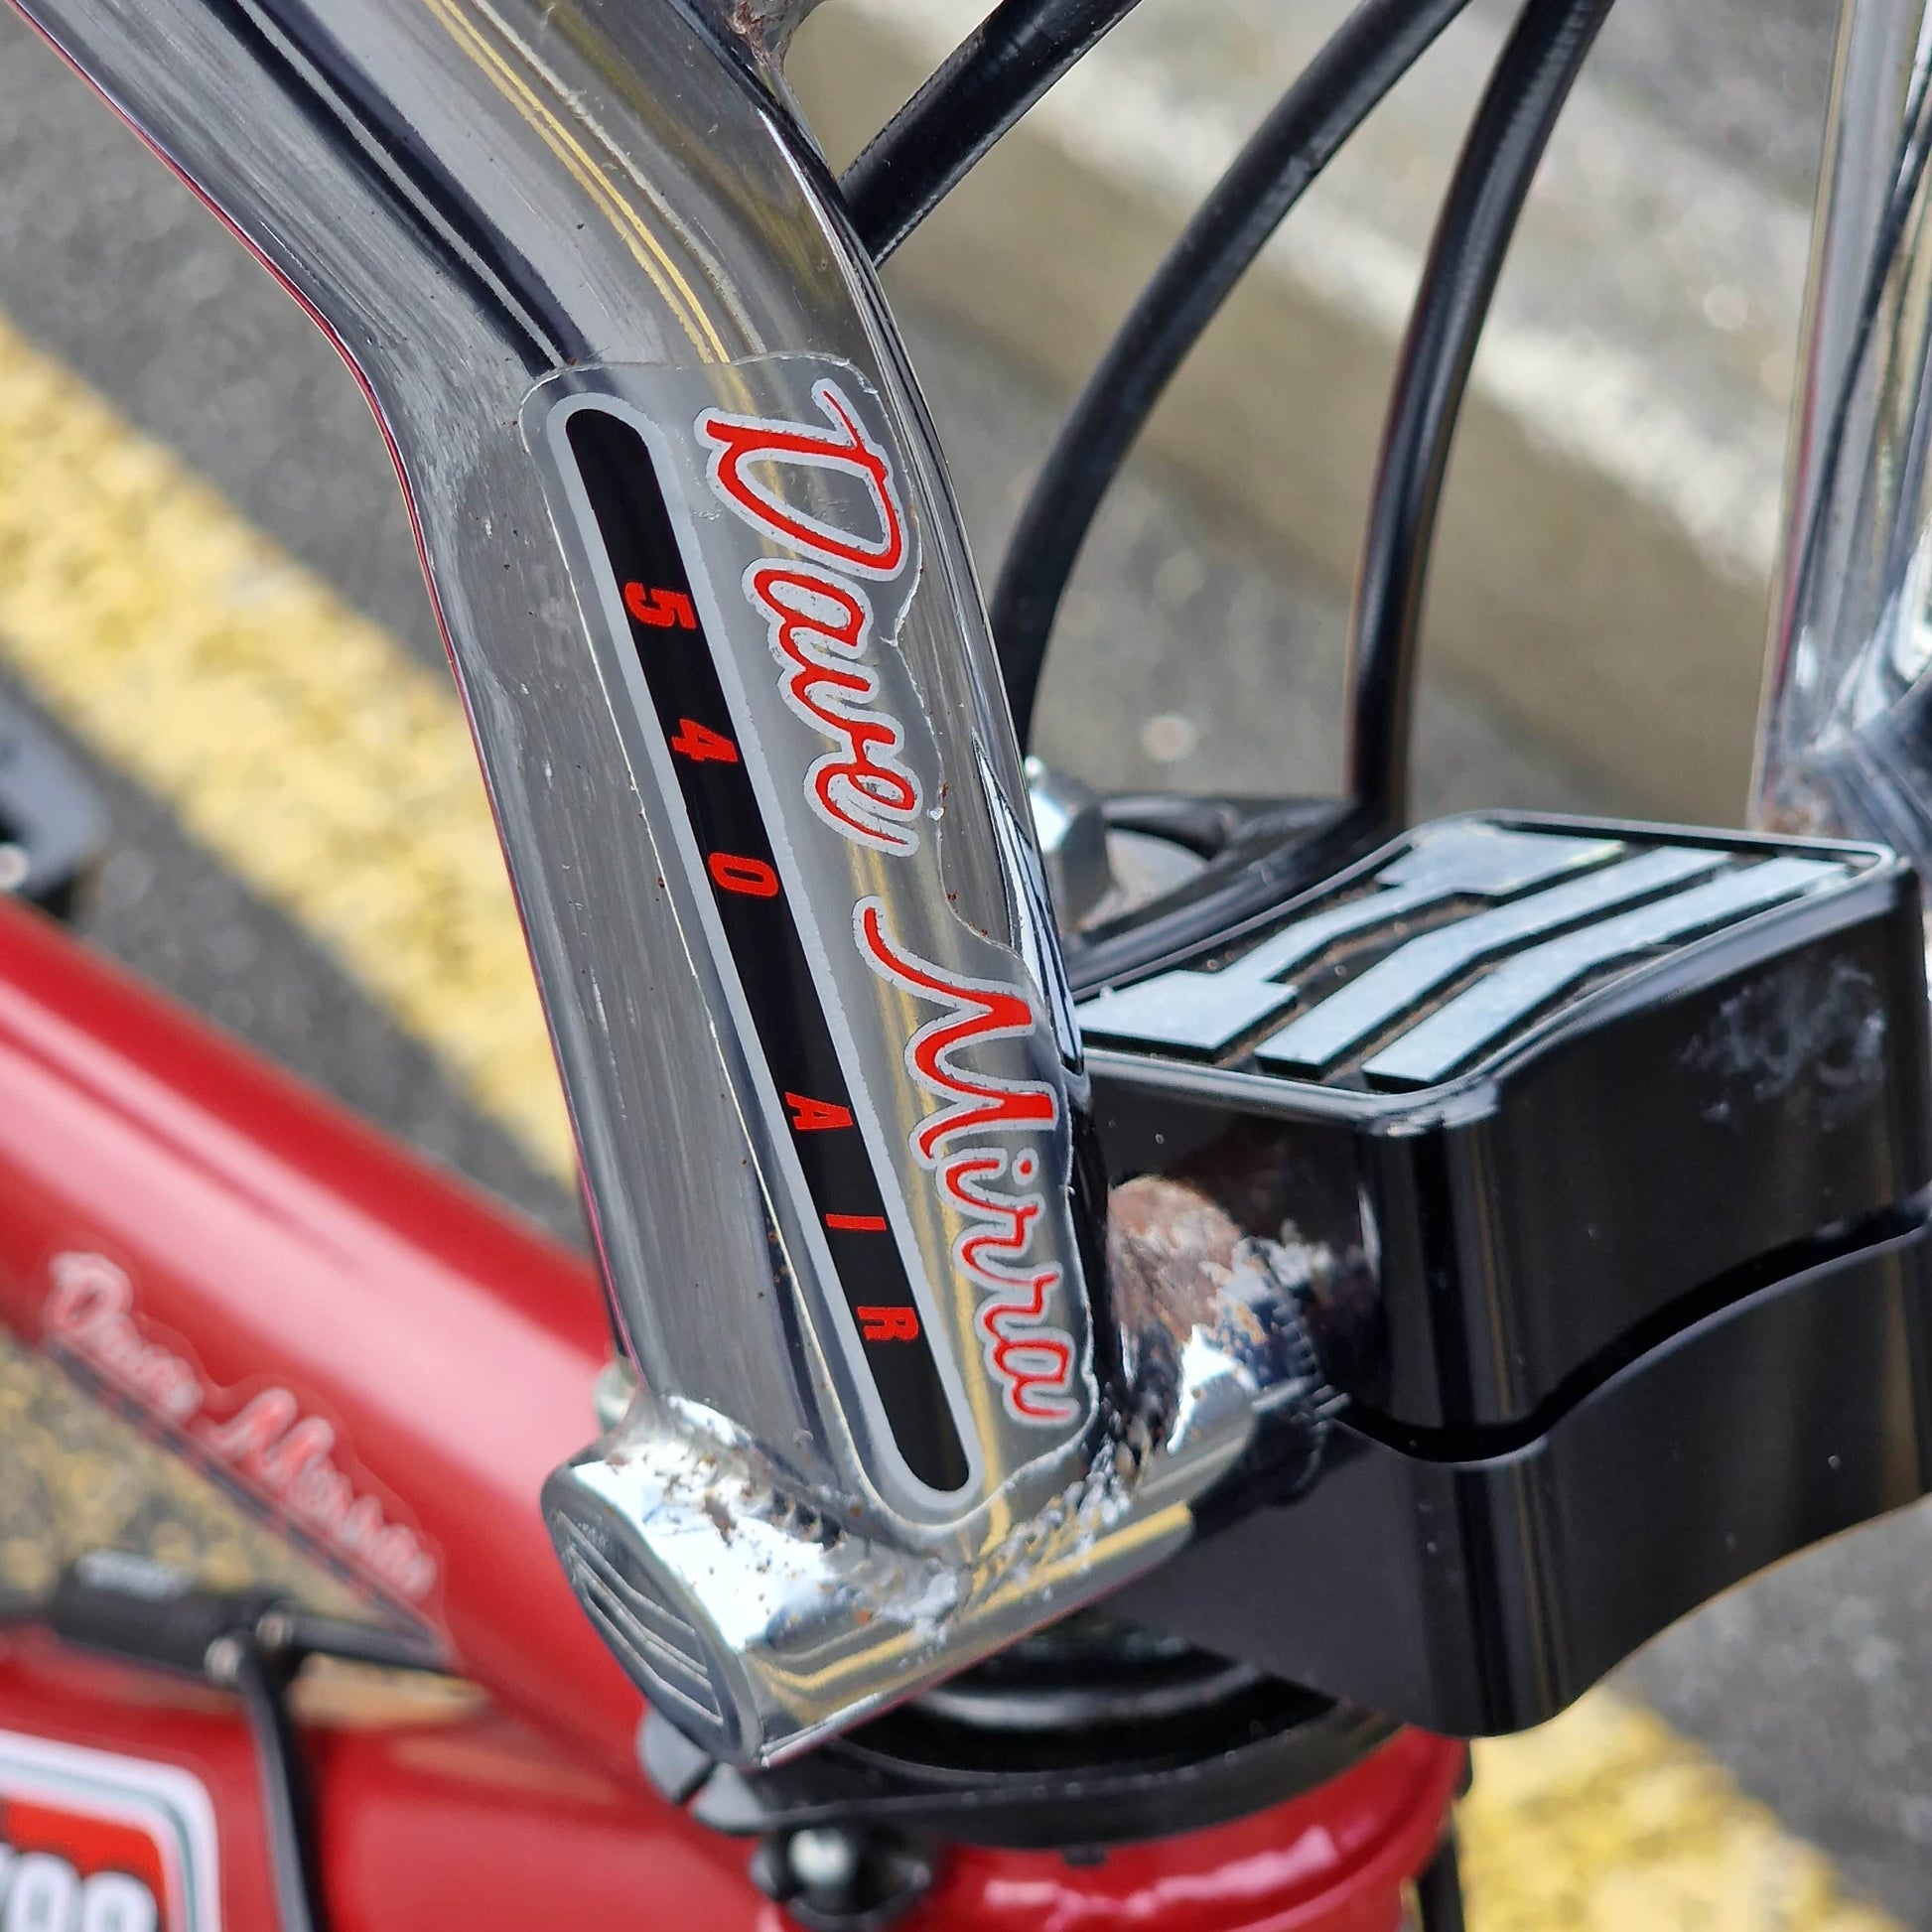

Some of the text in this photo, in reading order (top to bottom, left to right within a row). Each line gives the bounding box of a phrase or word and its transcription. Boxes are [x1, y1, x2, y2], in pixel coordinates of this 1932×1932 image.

[623, 582, 919, 1341] 540 AIR
[700, 383, 1081, 1423] Dave Mirra
